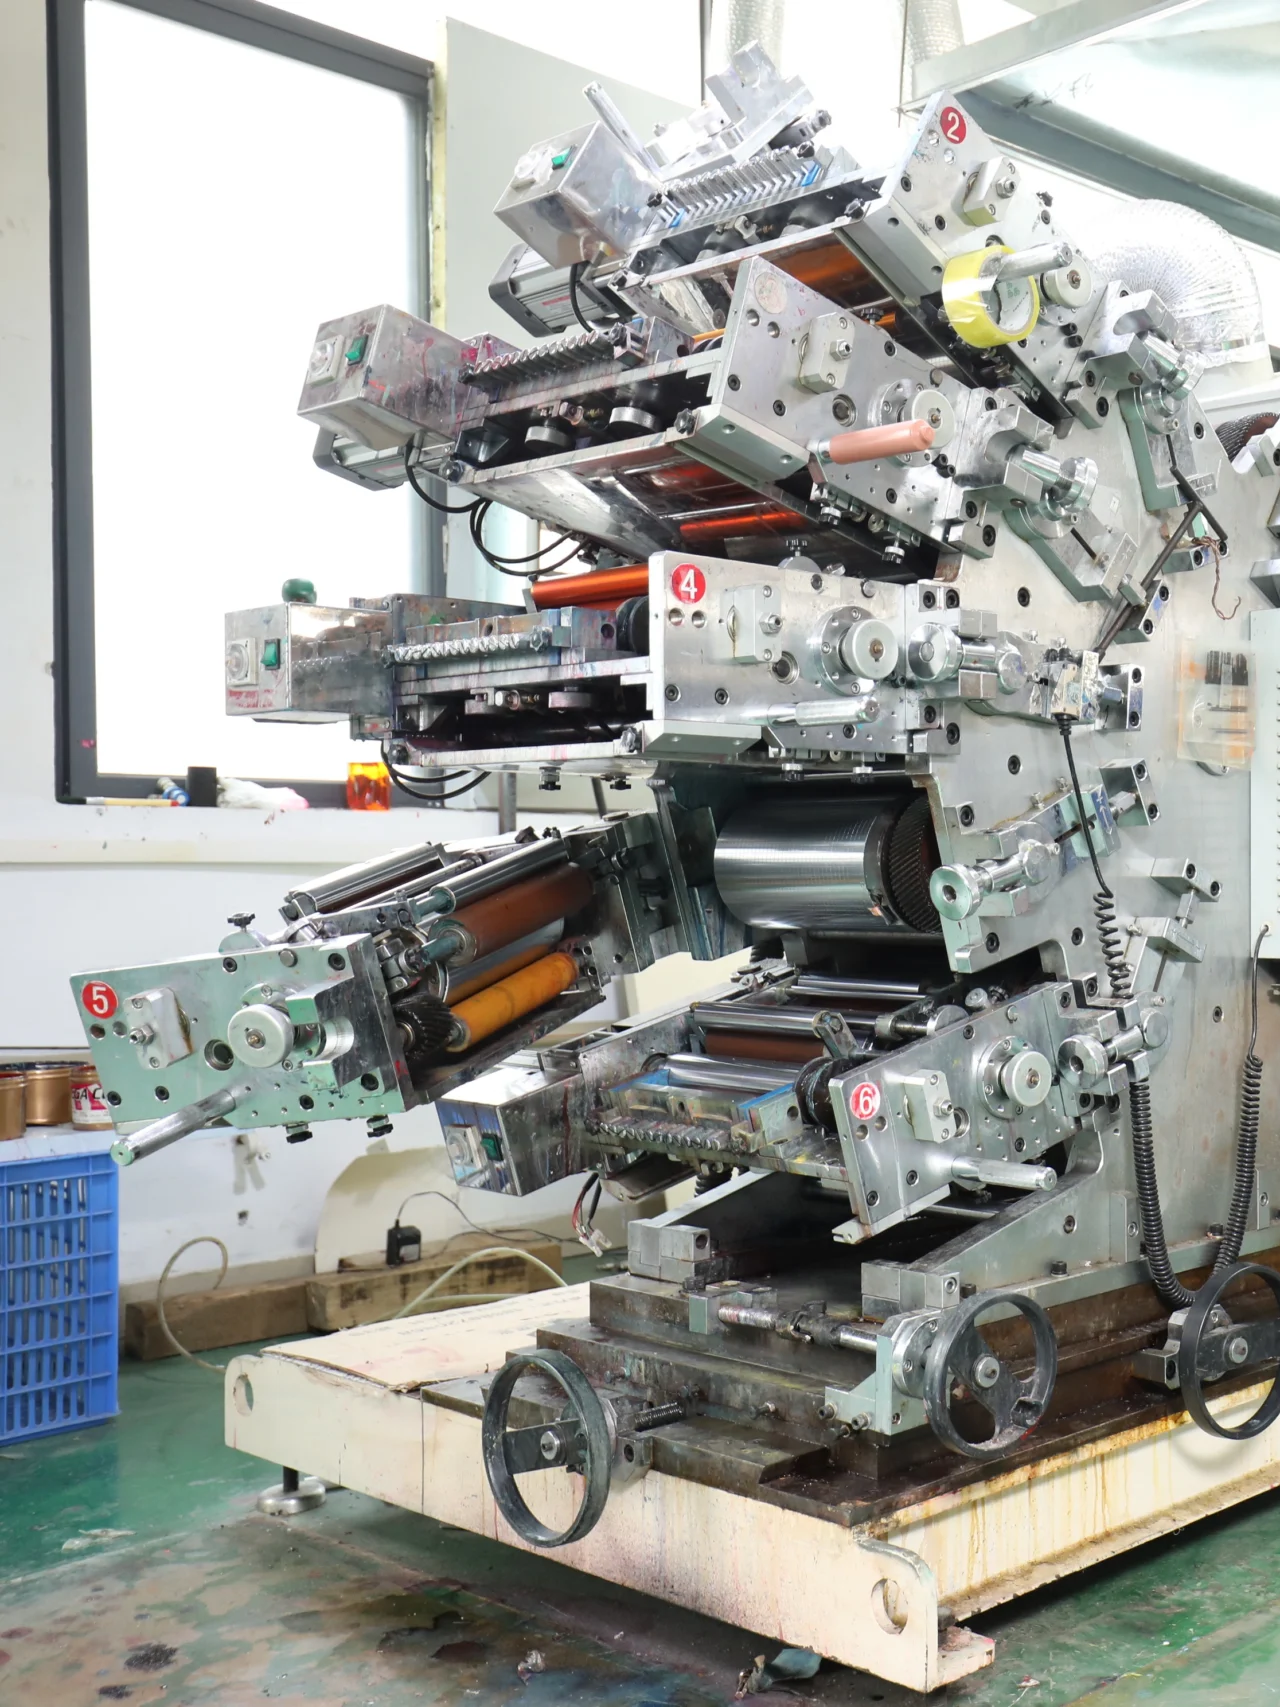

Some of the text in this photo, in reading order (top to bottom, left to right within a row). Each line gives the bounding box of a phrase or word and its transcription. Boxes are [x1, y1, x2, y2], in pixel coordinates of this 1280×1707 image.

[946, 111, 960, 142] 2
[680, 568, 698, 600] 4
[92, 985, 109, 1015] 5
[859, 1086, 873, 1115] 6
